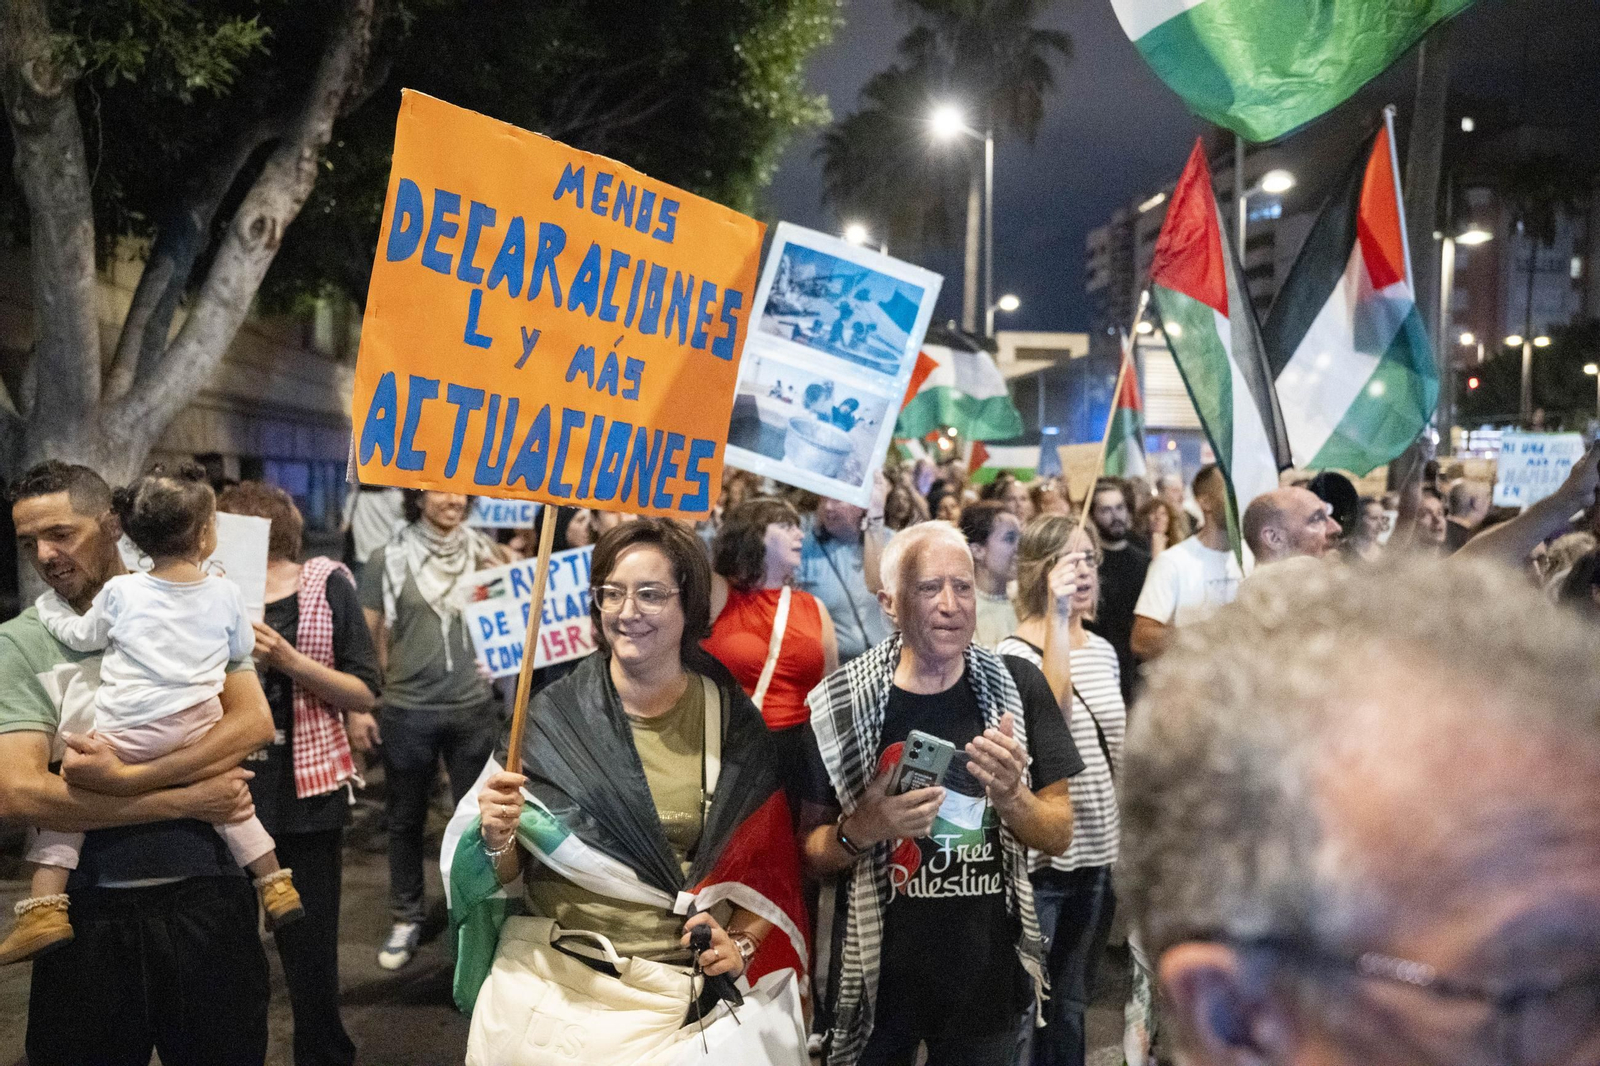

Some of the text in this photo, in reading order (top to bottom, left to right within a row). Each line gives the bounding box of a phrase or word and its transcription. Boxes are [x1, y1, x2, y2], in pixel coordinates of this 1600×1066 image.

[553, 162, 681, 244] MENOS
[565, 336, 646, 401] MÁS
[359, 371, 717, 512] ACTUACIONES
[479, 611, 510, 640] DE
[485, 625, 596, 672] CON ISR
[928, 834, 994, 873] Free
[887, 863, 1003, 904] Palestine
